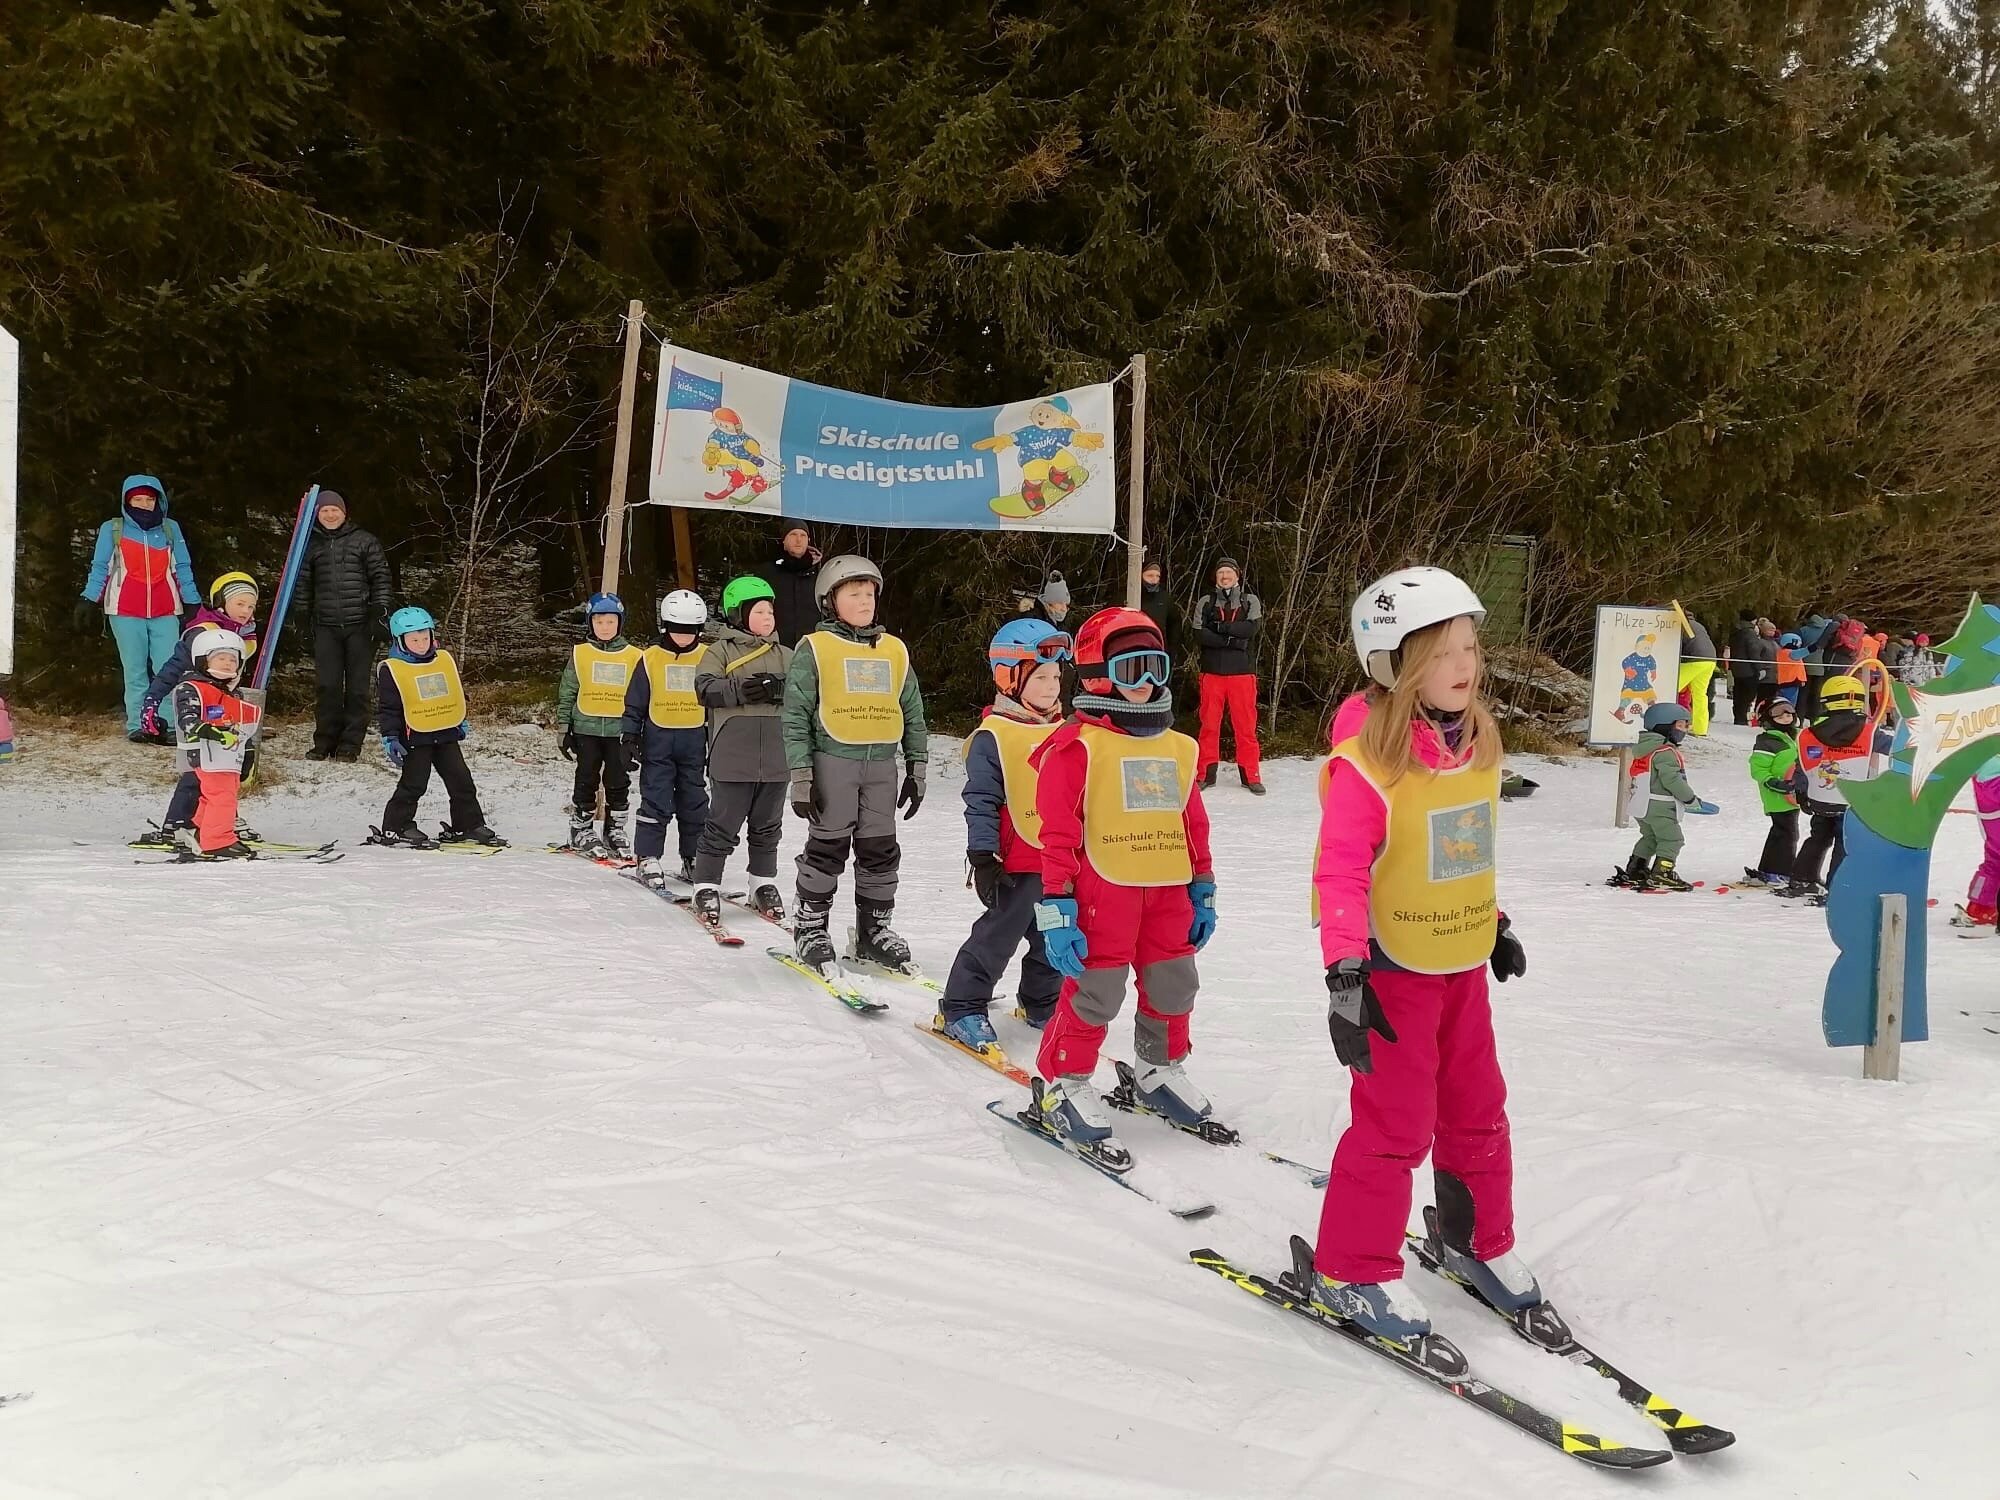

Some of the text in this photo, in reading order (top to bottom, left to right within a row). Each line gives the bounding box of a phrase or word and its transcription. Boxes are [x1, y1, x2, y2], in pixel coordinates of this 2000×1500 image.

[819, 425, 960, 451] Skischule
[795, 455, 985, 488] Predigtstuhl
[1373, 616, 1397, 624] uvex
[1102, 831, 1154, 844] Skischule
[1130, 843, 1156, 853] Sankt
[1393, 909, 1460, 923] Skischule
[1431, 925, 1462, 937] Sankt
